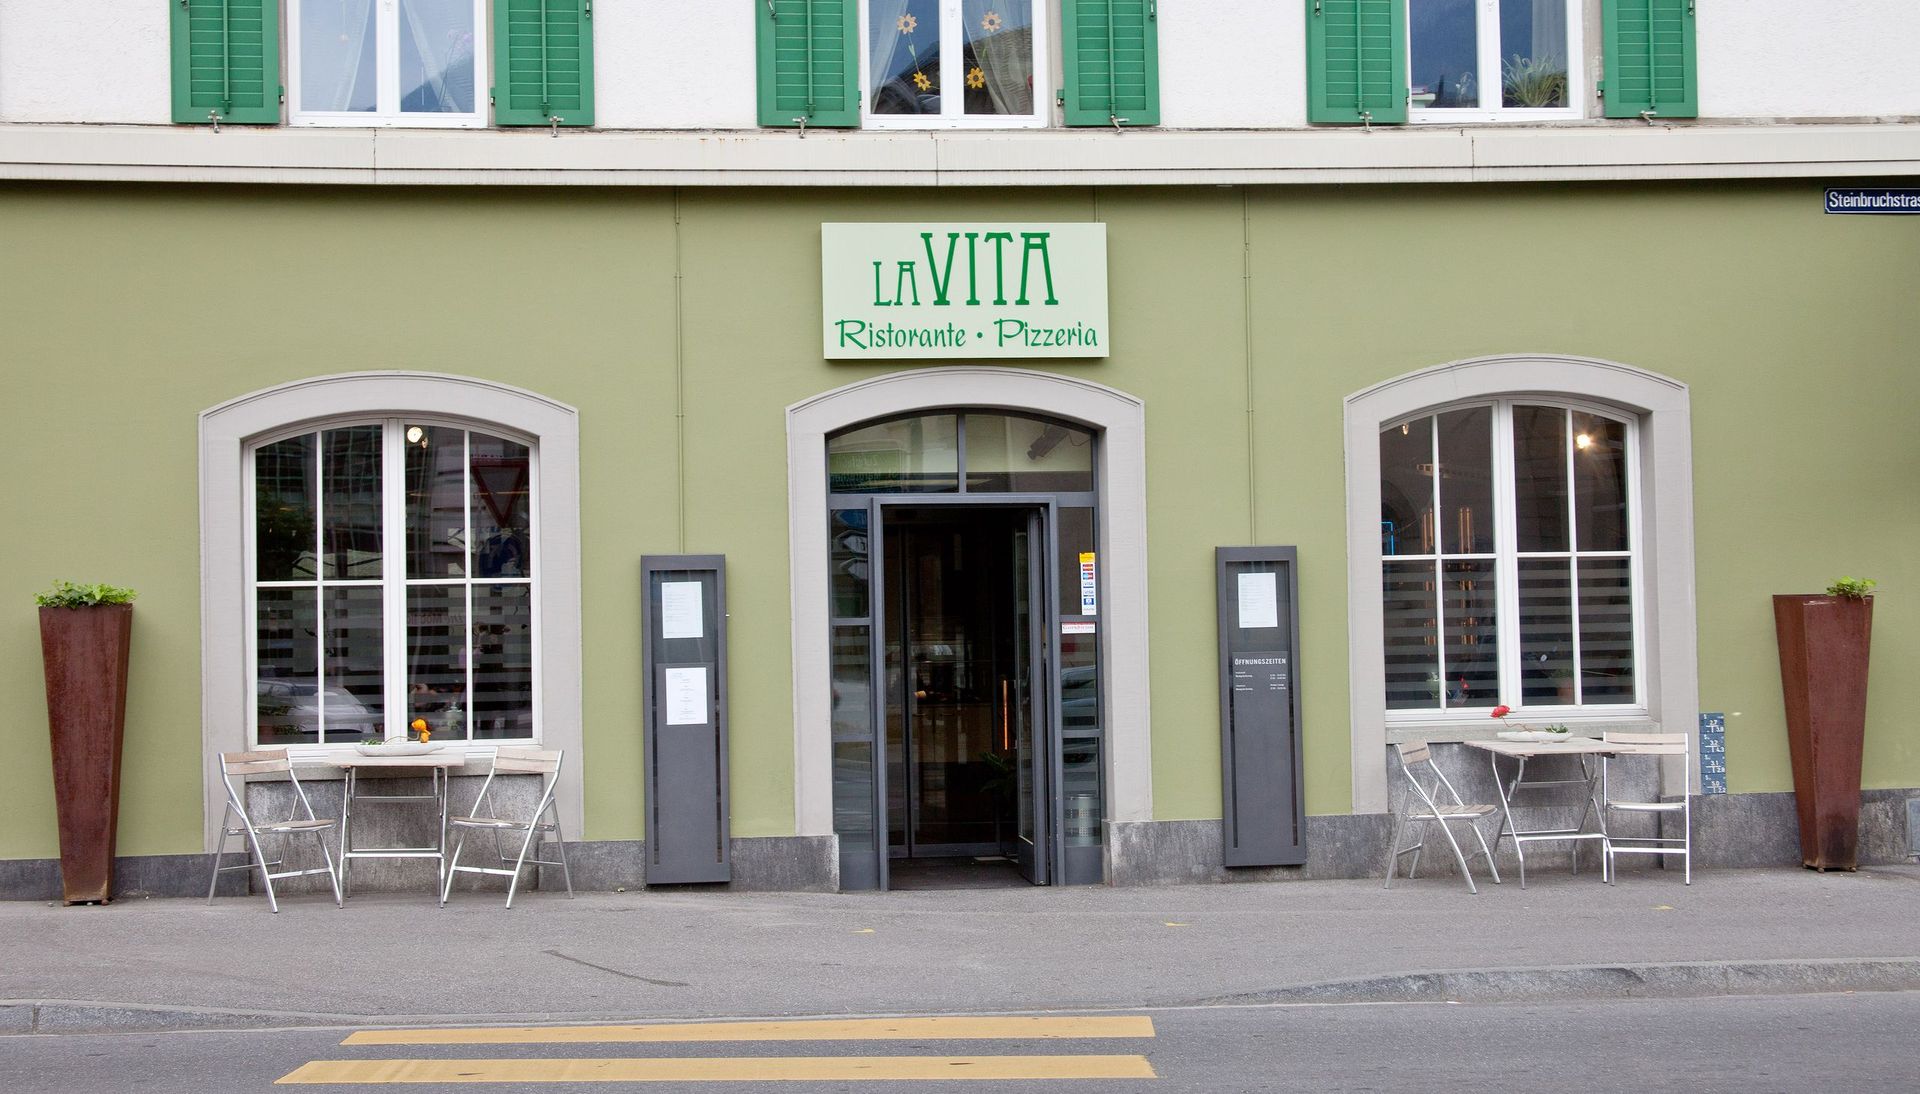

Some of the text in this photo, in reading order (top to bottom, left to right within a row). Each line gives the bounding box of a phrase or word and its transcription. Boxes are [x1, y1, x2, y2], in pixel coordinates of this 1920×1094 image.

[873, 232, 1059, 306] LA VITA
[834, 318, 1098, 351] Ristorante Pizzeria
